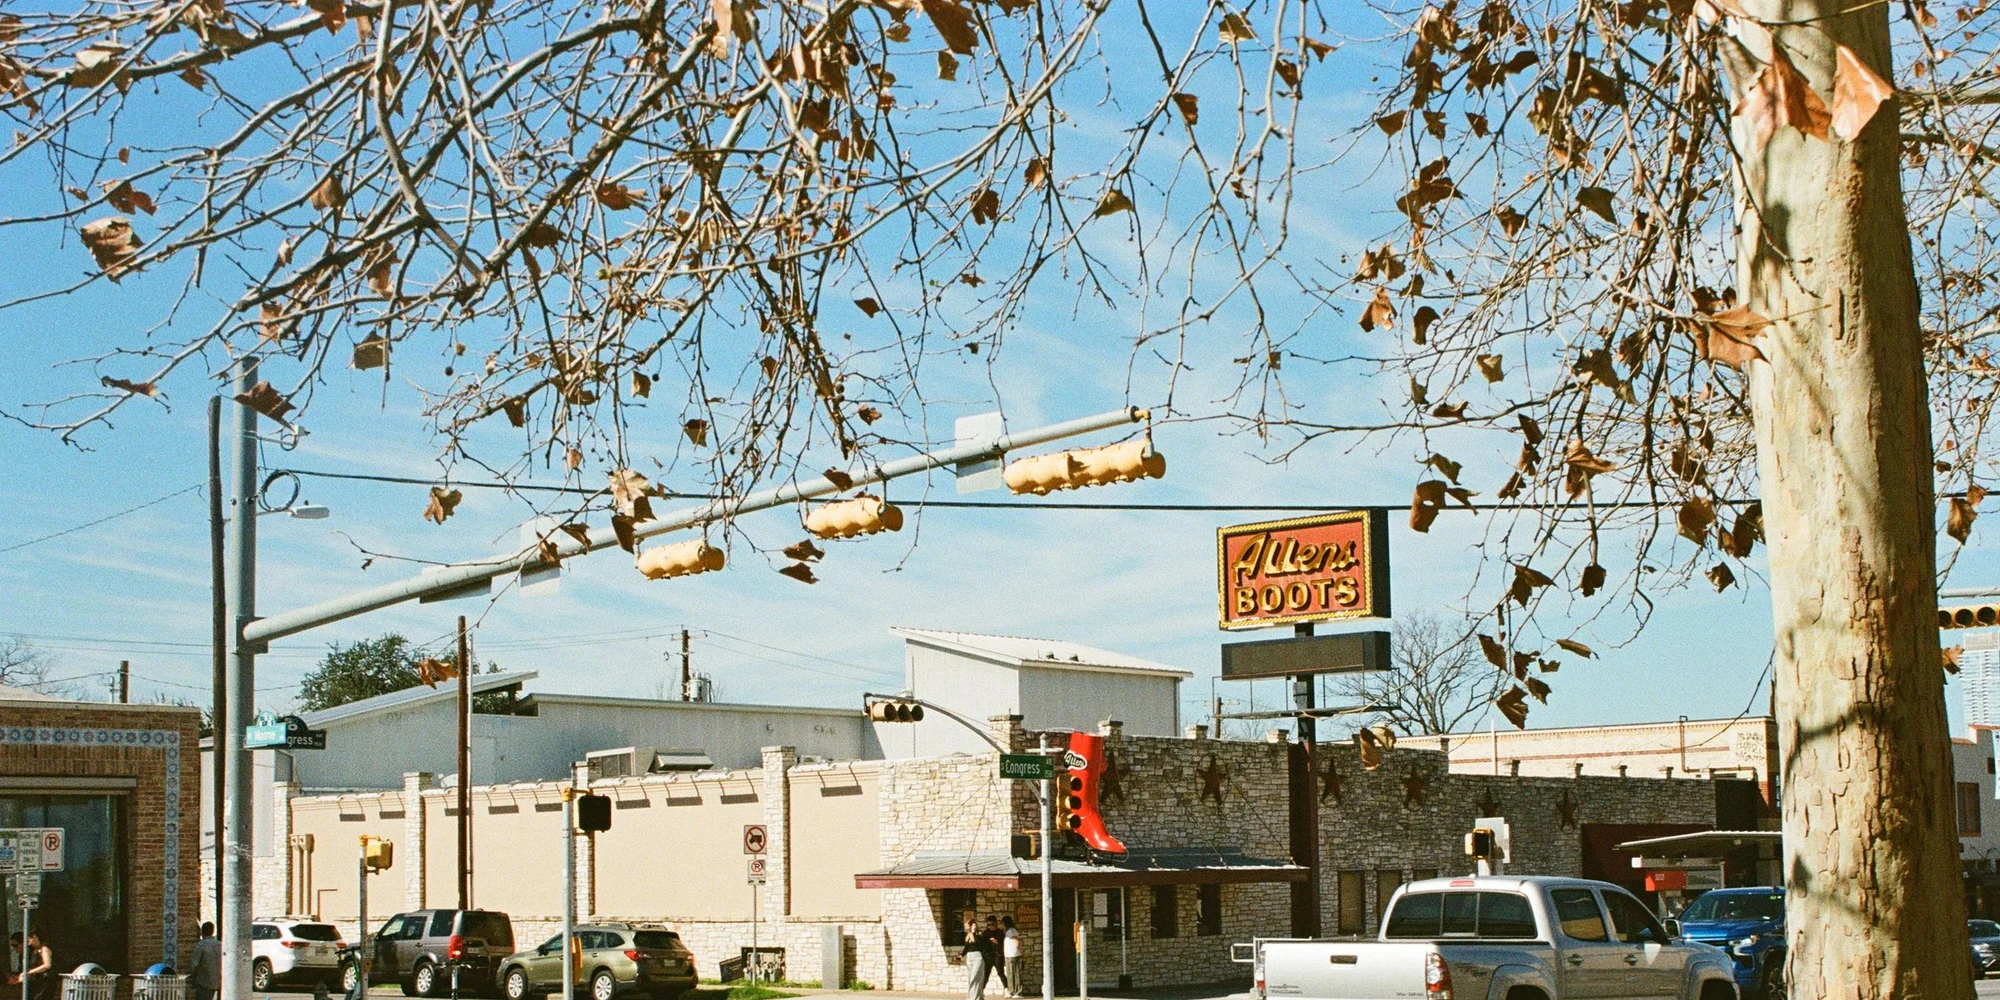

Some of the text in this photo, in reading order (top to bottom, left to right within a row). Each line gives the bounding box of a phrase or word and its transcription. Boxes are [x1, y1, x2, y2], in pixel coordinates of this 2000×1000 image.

[1231, 531, 1360, 586] Allens
[1234, 576, 1360, 616] BOOTS
[286, 736, 313, 747] gress
[1005, 760, 1040, 776] Congress
